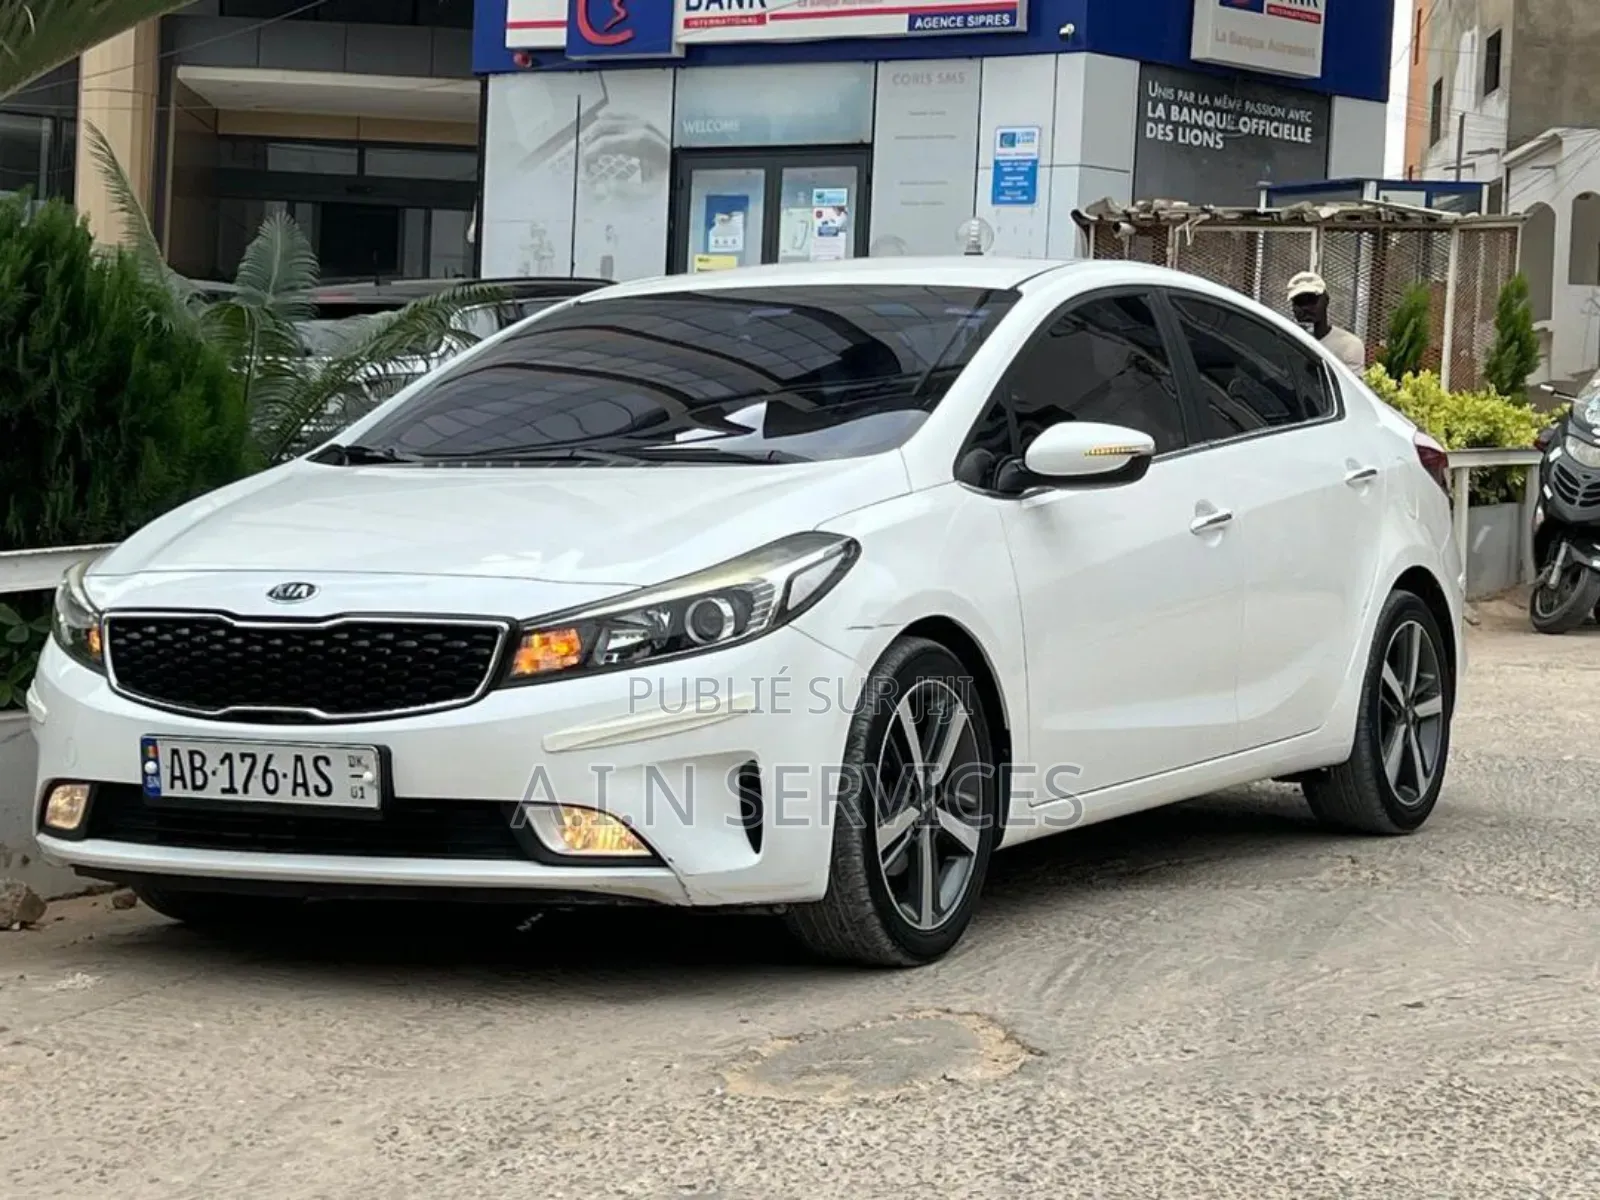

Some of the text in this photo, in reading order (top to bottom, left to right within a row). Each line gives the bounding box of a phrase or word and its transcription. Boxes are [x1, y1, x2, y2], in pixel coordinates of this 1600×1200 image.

[914, 13, 1010, 29] AGENCE SIPRES
[892, 72, 965, 85] CORIS SMS
[1177, 89, 1195, 104] PAR
[1198, 93, 1210, 106] LA
[1245, 101, 1285, 118] PASSION
[1287, 109, 1312, 123] AVEC
[1147, 101, 1312, 143] LA BANQUE OFFICIELLE
[1146, 122, 1224, 149] DES LIONS
[269, 582, 313, 600] KIA
